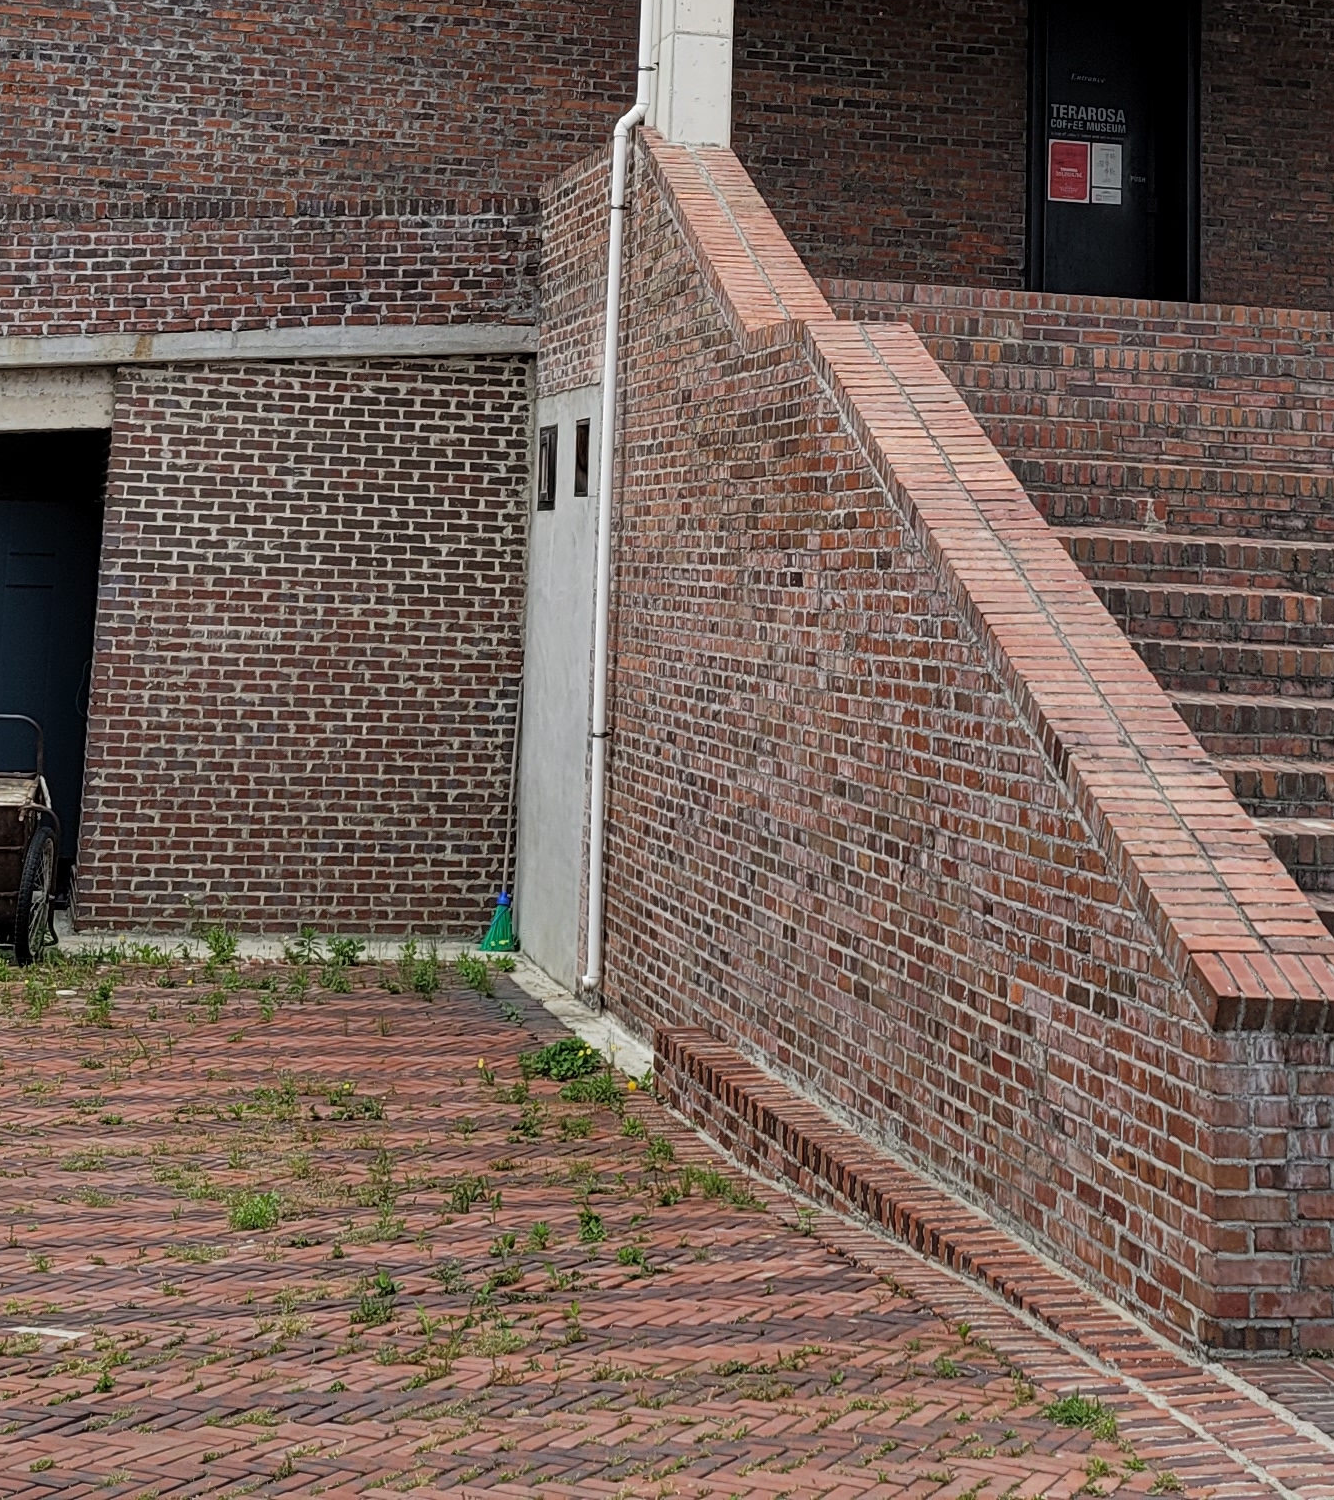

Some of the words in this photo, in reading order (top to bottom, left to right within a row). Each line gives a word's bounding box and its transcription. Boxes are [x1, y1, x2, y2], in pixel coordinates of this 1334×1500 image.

[1071, 73, 1106, 83] Entrance
[1051, 104, 1125, 123] TERAROSA
[1051, 119, 1084, 130] COFFEE
[1086, 122, 1126, 133] MUSEUM
